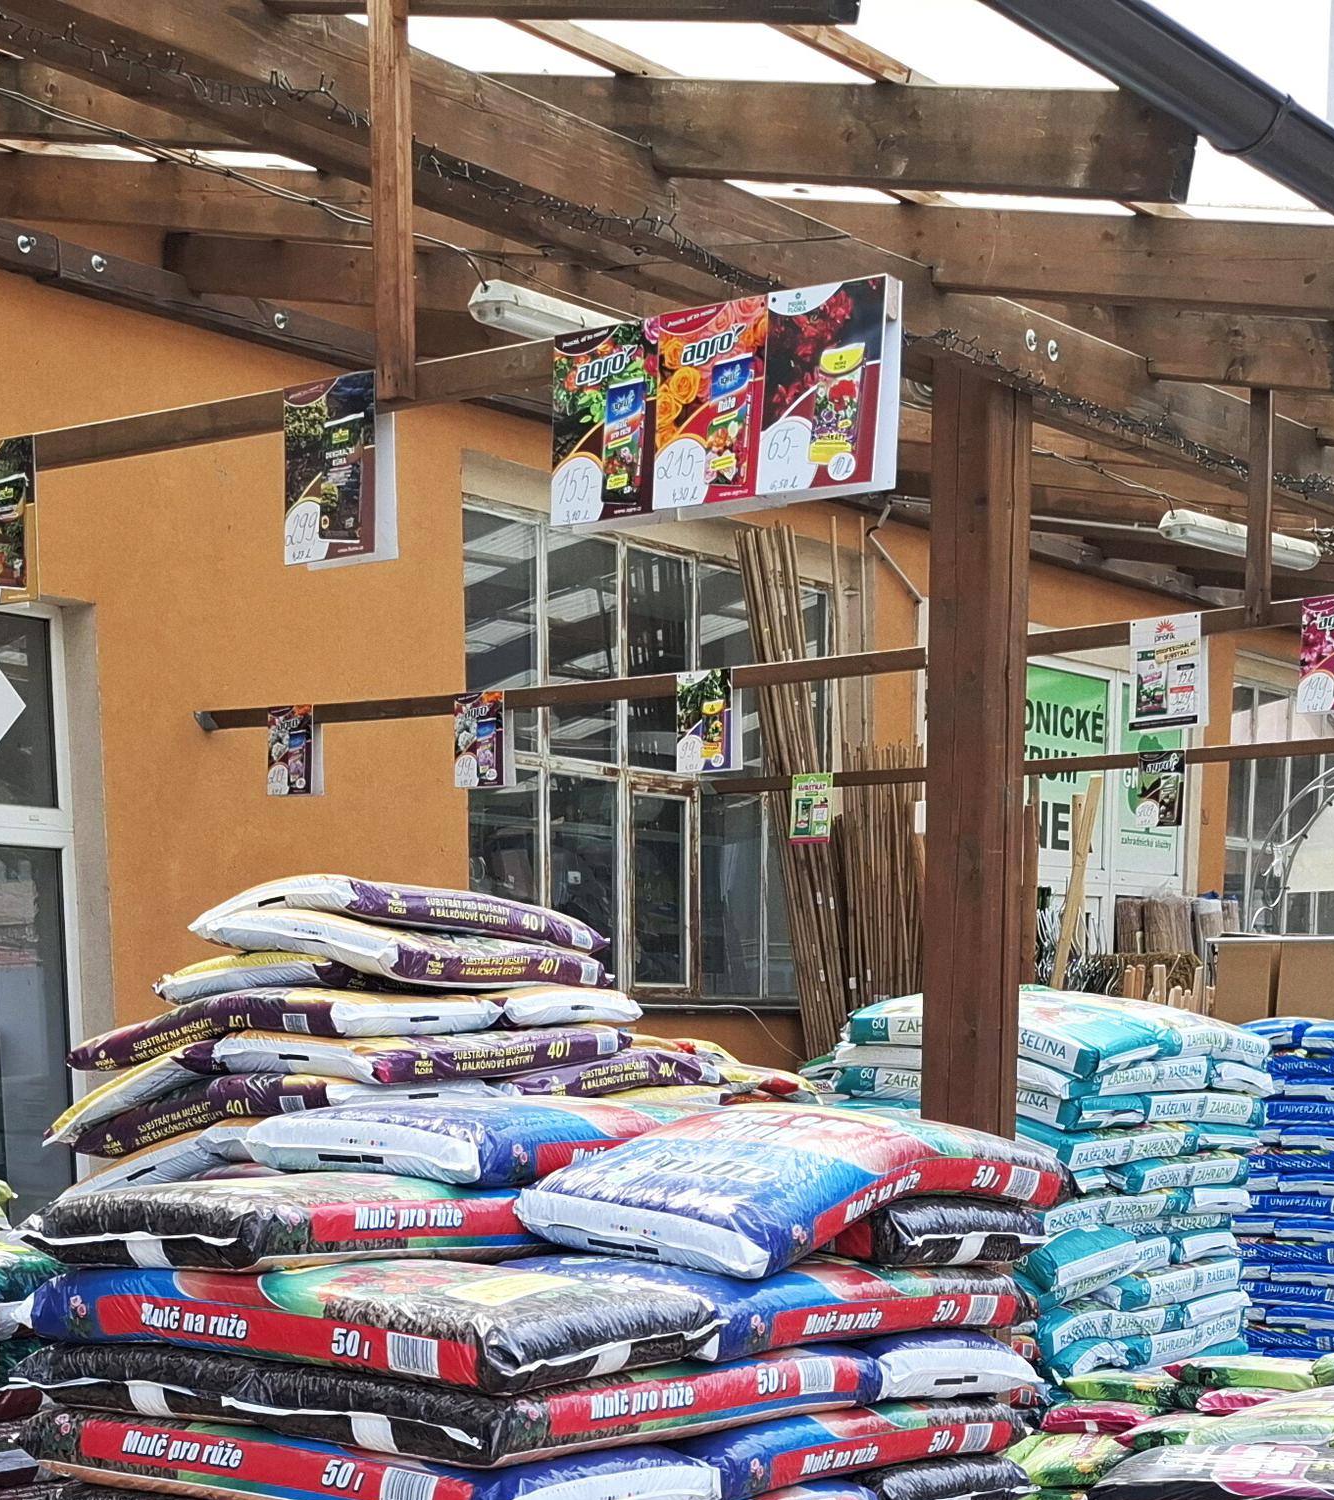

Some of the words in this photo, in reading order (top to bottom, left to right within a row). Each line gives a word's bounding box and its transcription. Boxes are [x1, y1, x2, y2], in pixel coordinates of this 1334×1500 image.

[681, 331, 733, 366] agro
[575, 350, 625, 386] agro
[522, 914, 538, 931] 40
[538, 959, 554, 974] 40
[141, 1303, 181, 1329] Mulč
[183, 1311, 206, 1334] na
[210, 1310, 247, 1339] ruže
[802, 1310, 834, 1336] Mulč
[835, 1311, 855, 1331] na
[331, 1328, 361, 1357] 50
[591, 1392, 627, 1421] Mulč
[628, 1388, 658, 1414] pro
[661, 1379, 695, 1409] růže
[757, 1367, 777, 1395] 50
[122, 1429, 168, 1458] Mulč
[168, 1441, 199, 1467] pro
[202, 1439, 243, 1468] růže
[321, 1459, 353, 1489] 50
